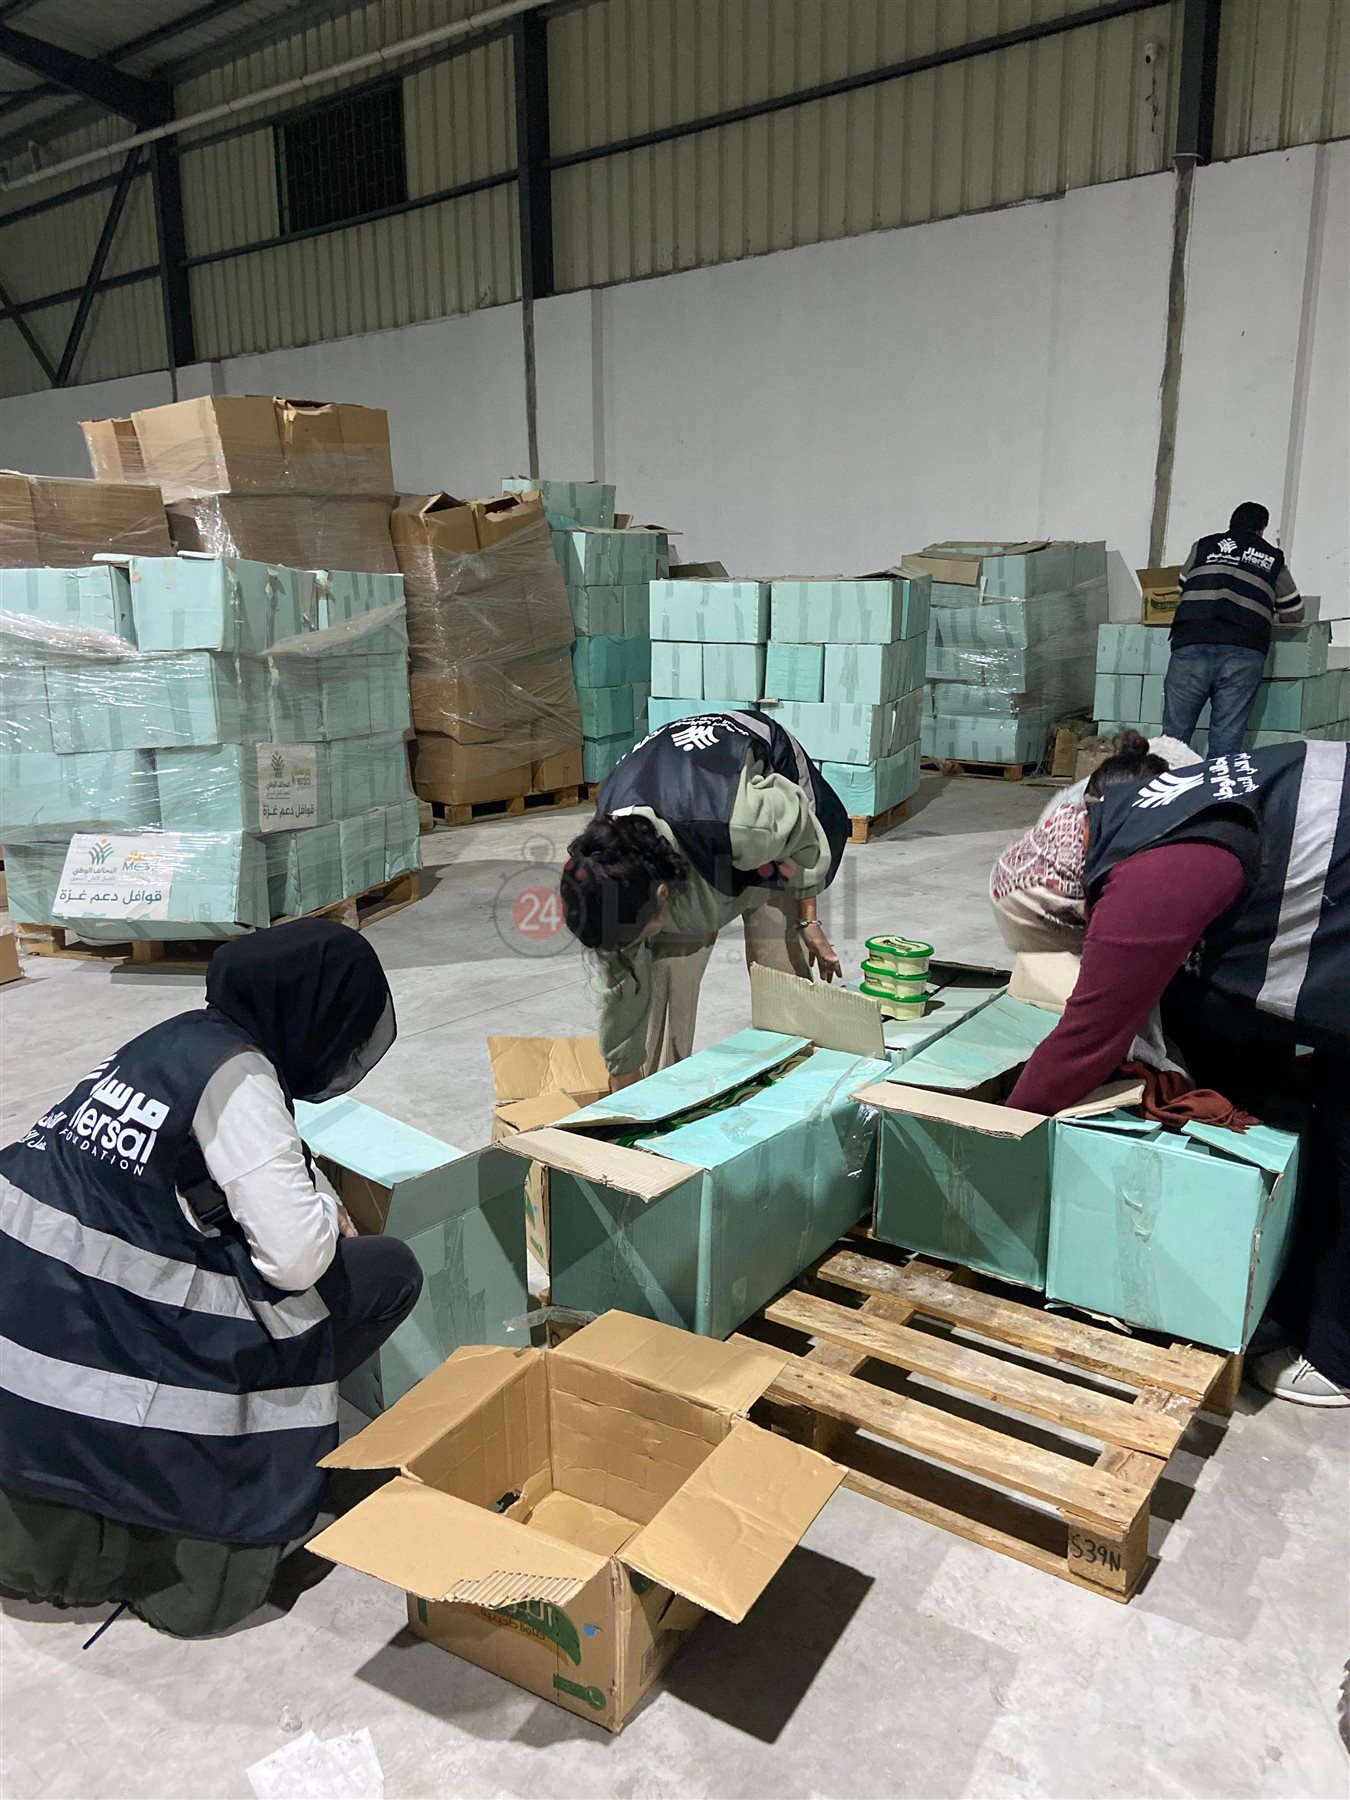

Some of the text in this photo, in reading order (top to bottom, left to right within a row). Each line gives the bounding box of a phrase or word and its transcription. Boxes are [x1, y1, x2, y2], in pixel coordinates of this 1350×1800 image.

[263, 804, 315, 819] قوافل دعم غزة
[60, 889, 162, 905] قوافل دعم غزة
[1071, 1534, 1121, 1572] S39N
